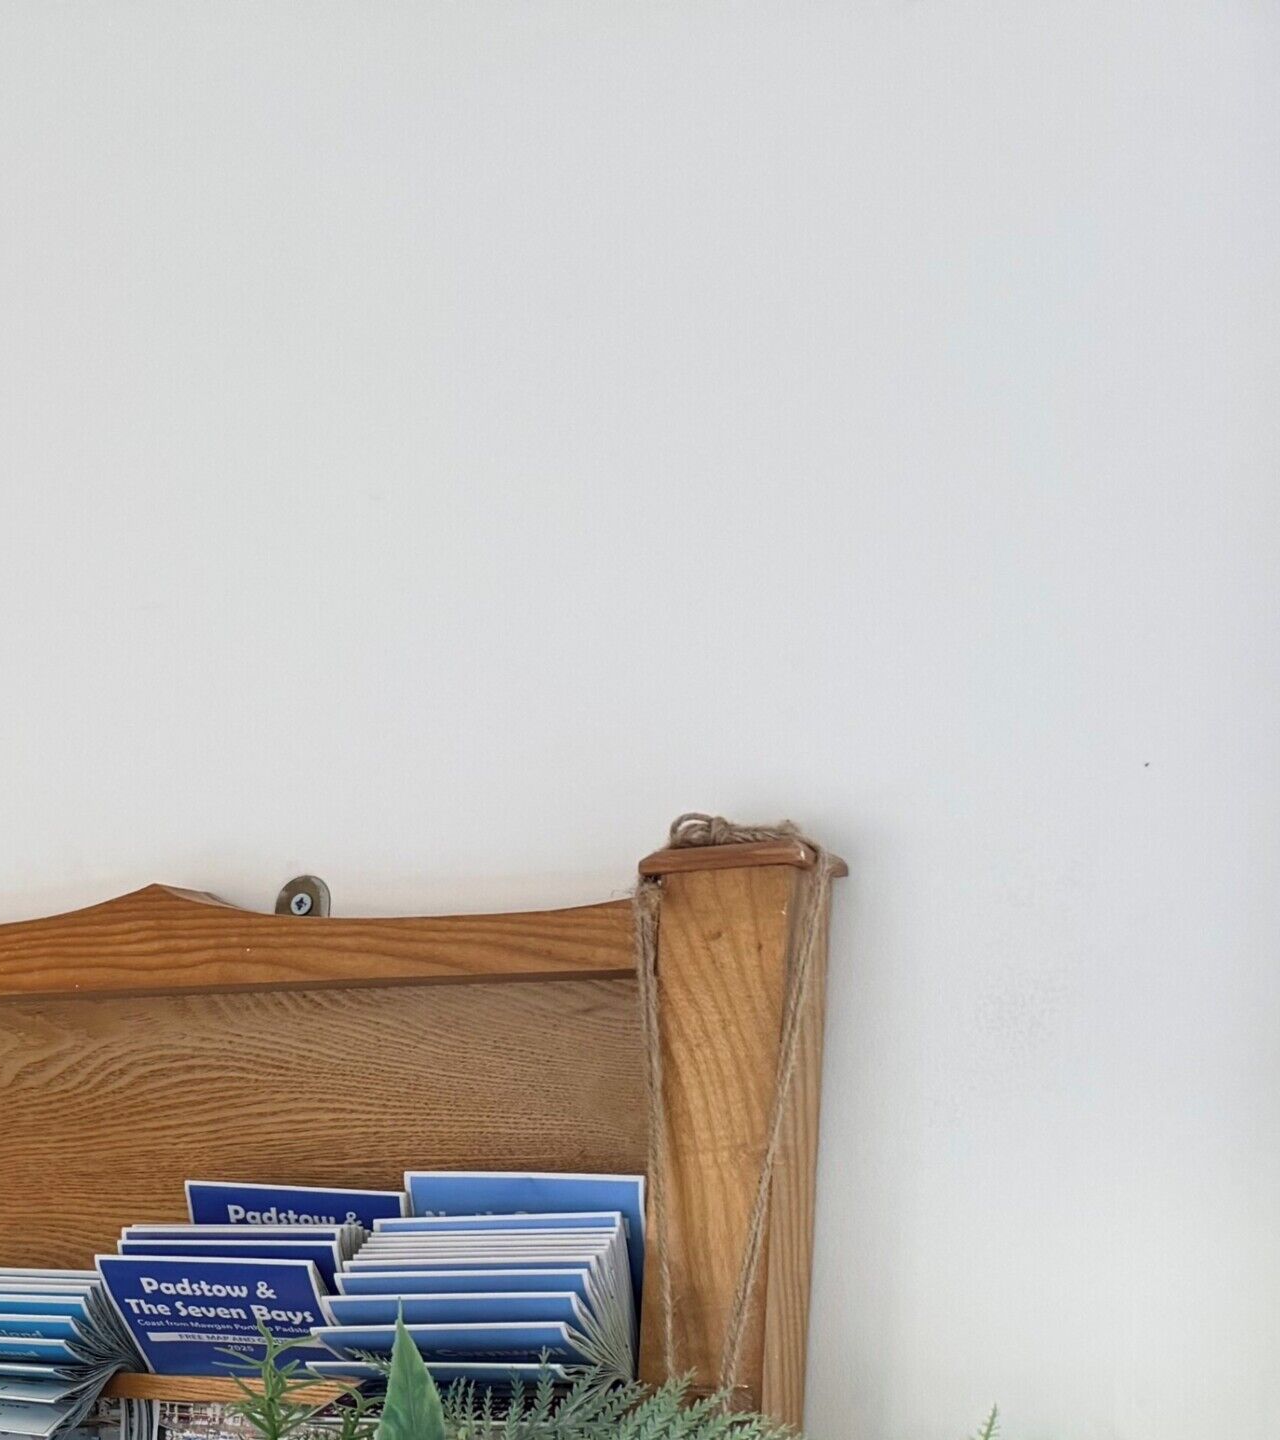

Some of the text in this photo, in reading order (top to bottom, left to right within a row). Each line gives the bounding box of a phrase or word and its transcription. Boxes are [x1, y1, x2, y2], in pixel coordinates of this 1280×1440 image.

[140, 1277, 277, 1299] Padstow &
[125, 1298, 314, 1323] The Seven Bays
[166, 1319, 188, 1327] from
[190, 1321, 232, 1331] Mawgan
[275, 1325, 310, 1334] Padsto
[206, 1335, 232, 1343] MAP
[233, 1336, 256, 1344] AND
